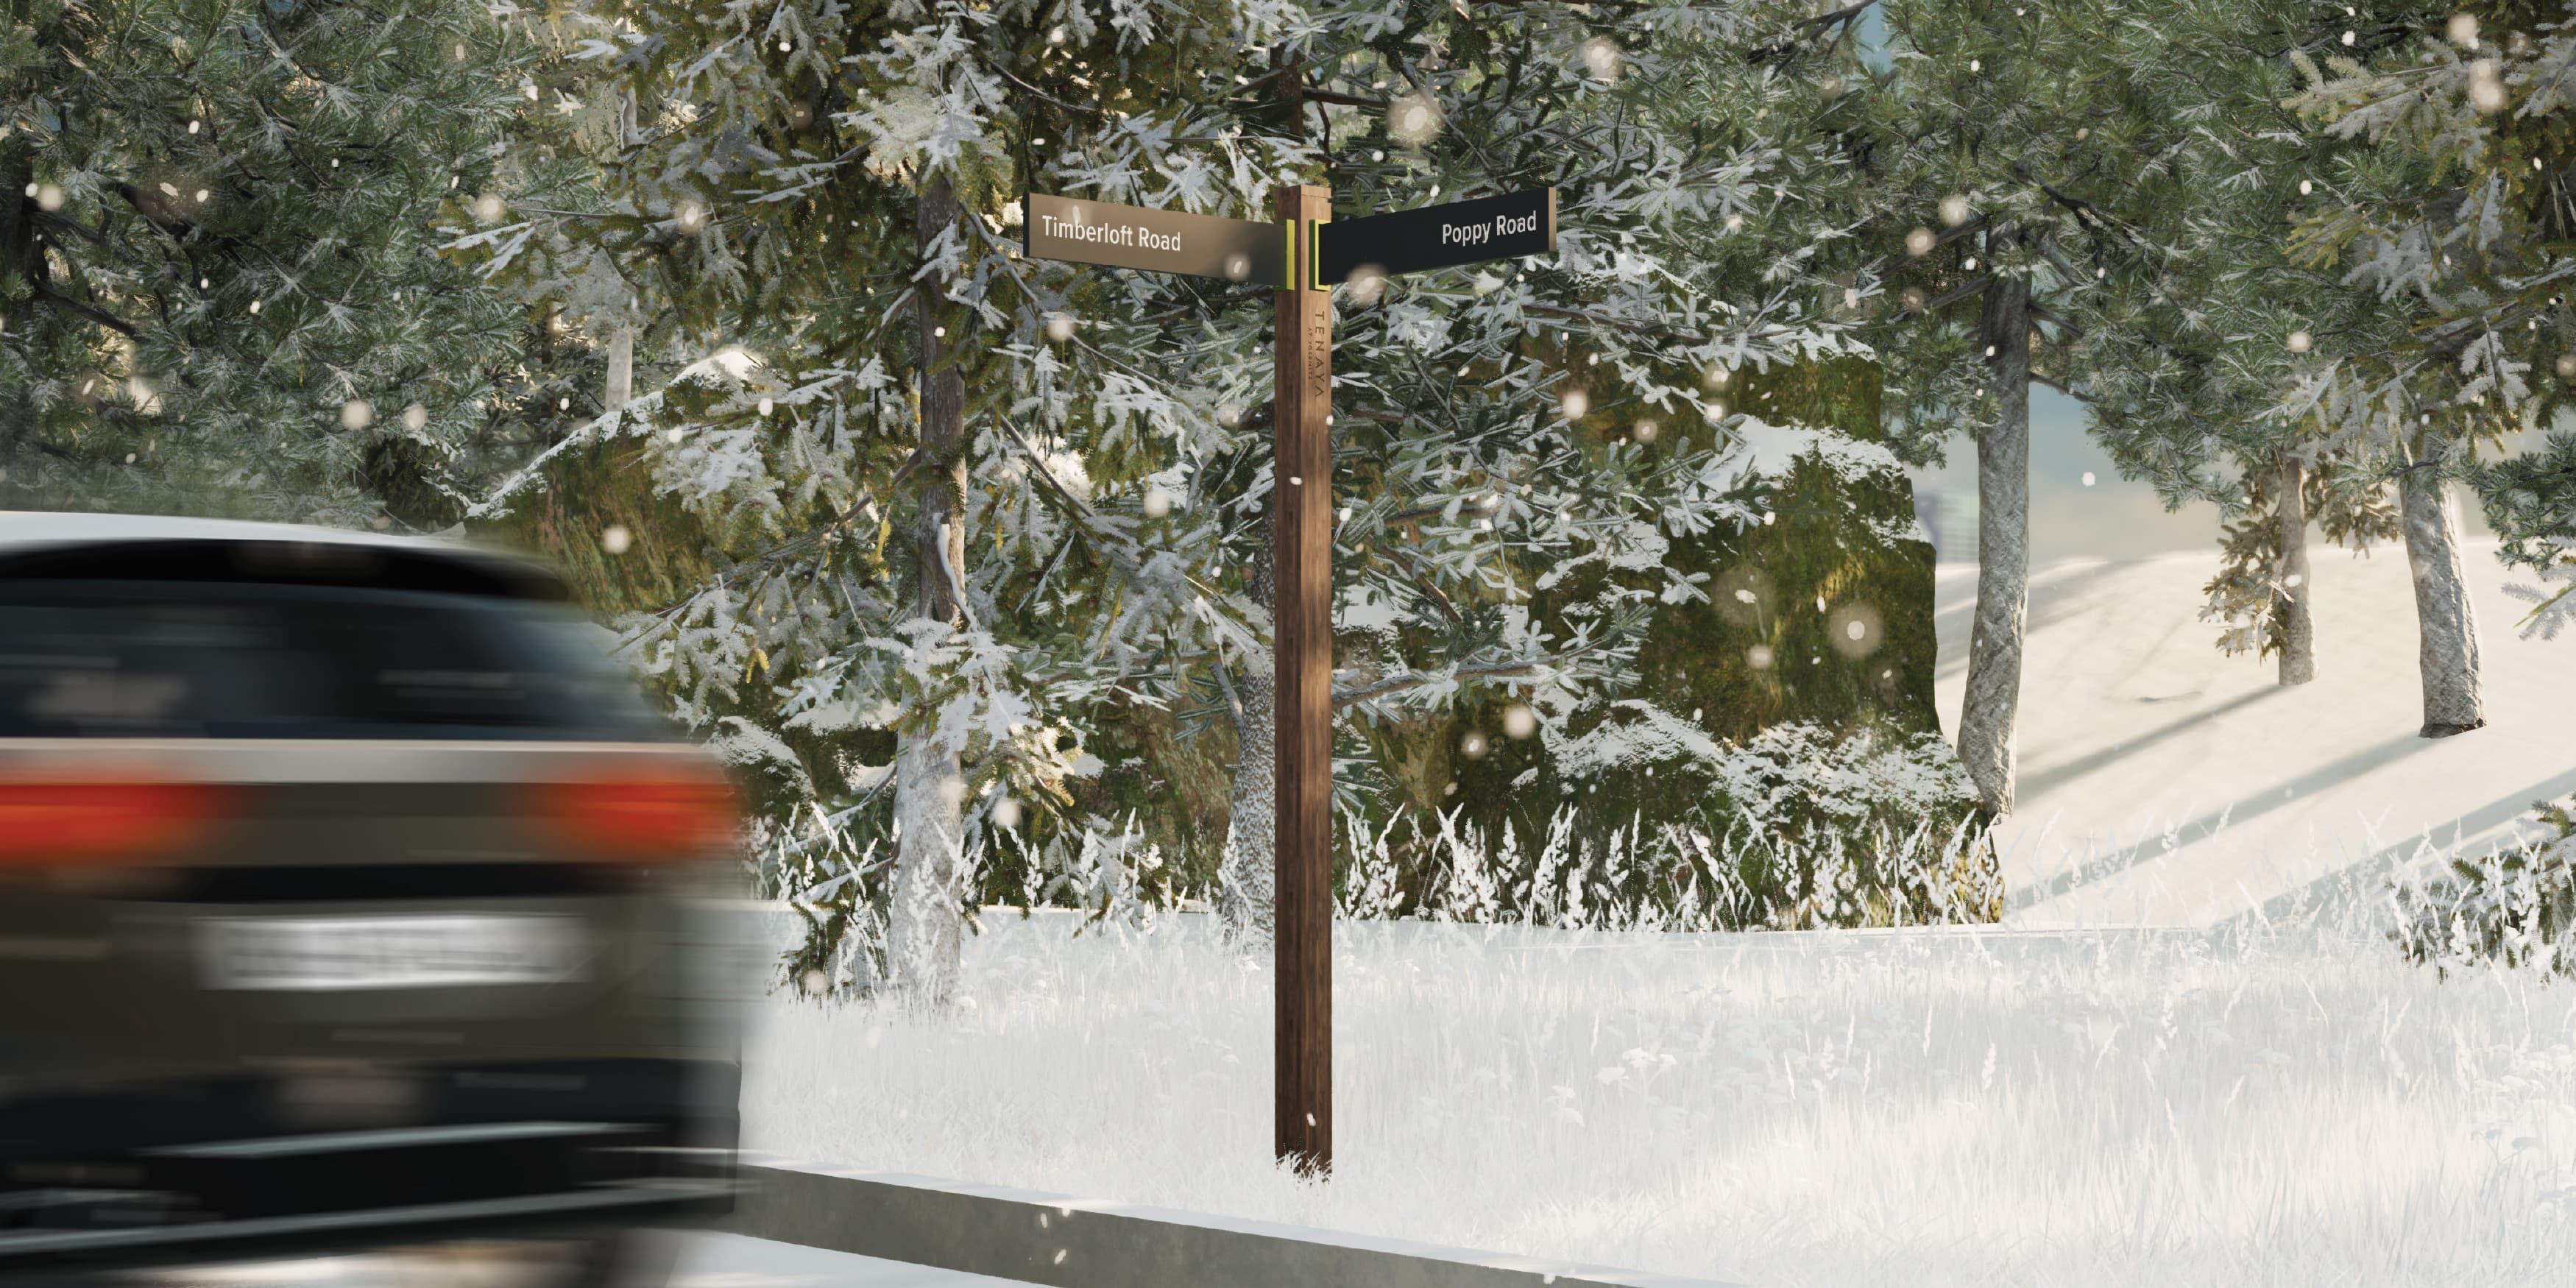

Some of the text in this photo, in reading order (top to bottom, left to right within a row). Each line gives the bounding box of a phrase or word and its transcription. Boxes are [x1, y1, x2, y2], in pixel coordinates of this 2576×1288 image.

[1041, 215, 1181, 252] Timberloft Road
[1442, 210, 1537, 247] Poppy Road
[1307, 328, 1313, 337] AT
[1314, 311, 1325, 397] TENAYA
